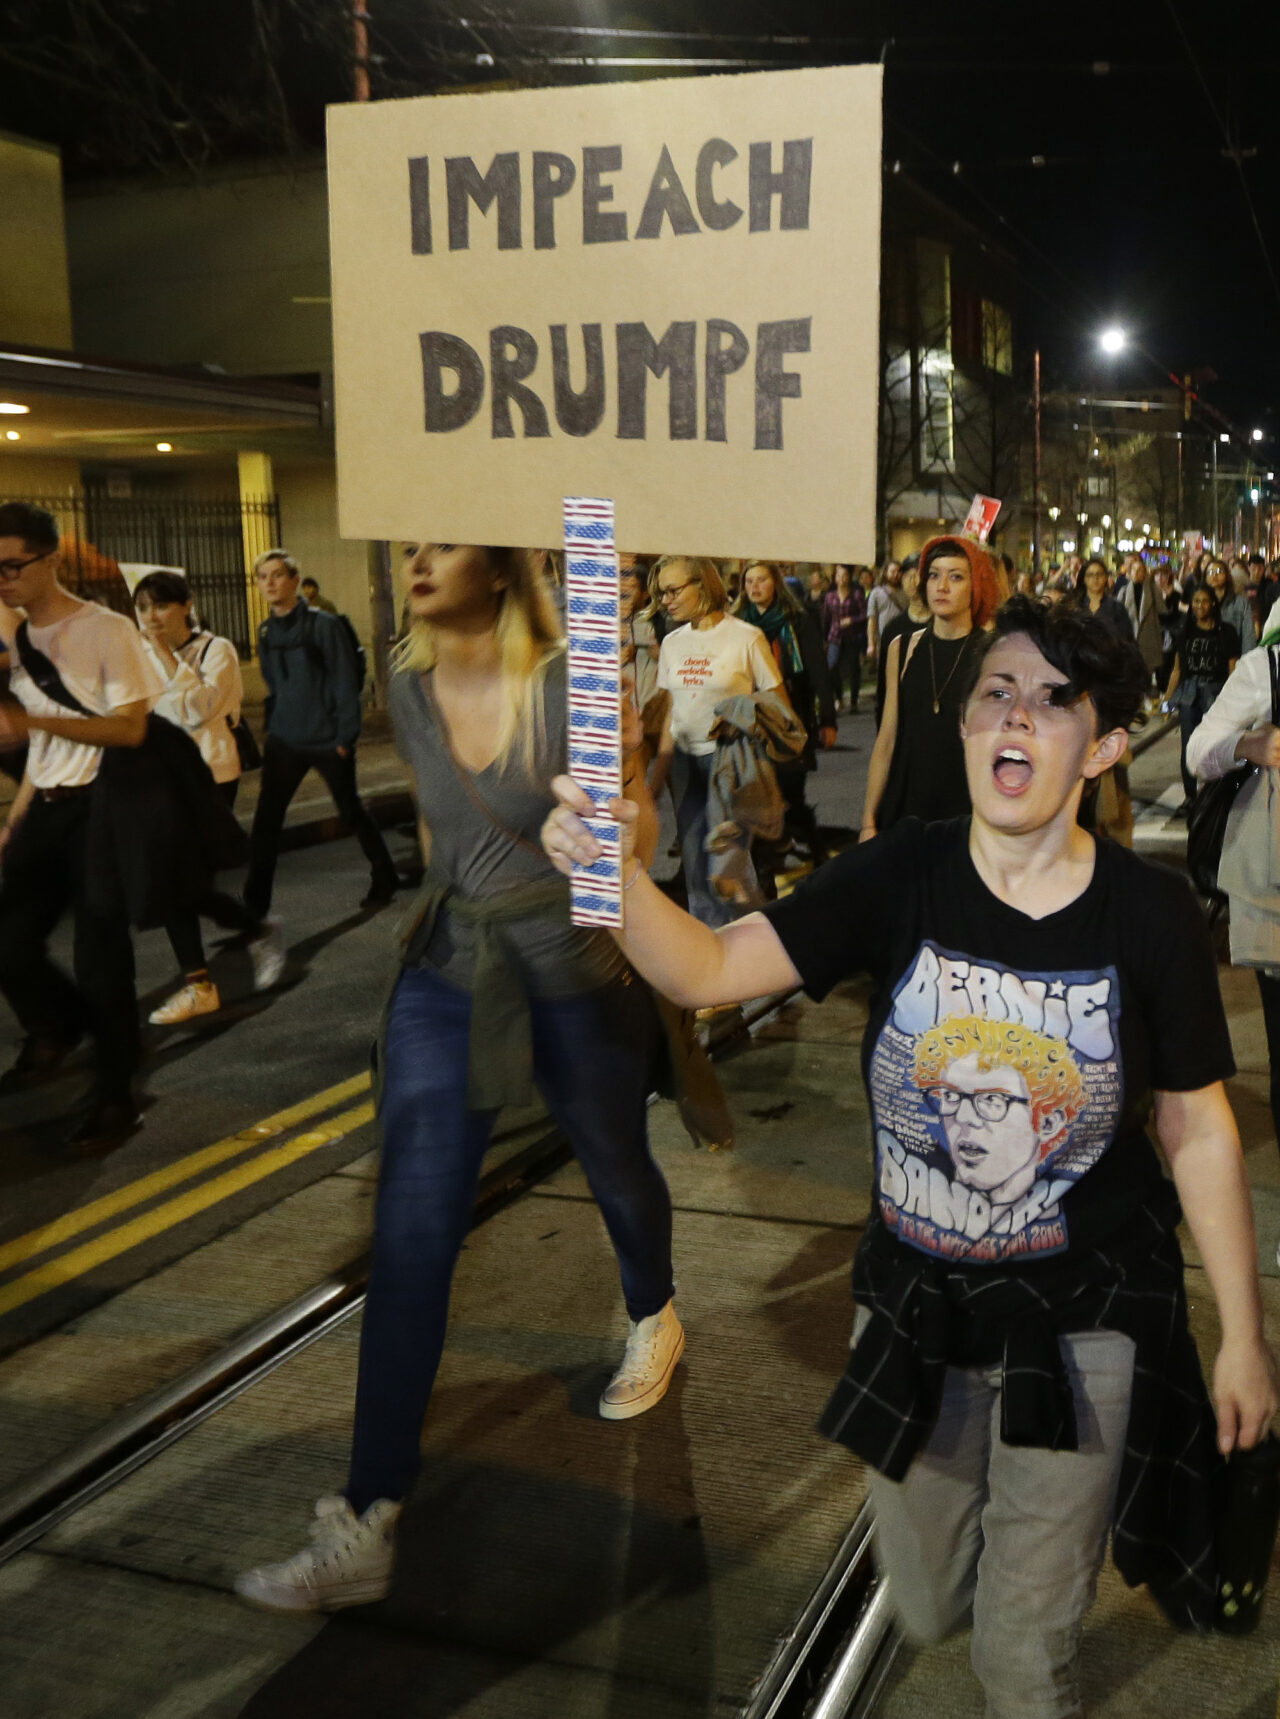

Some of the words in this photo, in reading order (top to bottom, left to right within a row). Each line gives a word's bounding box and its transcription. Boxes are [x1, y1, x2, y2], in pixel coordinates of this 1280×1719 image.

[407, 137, 813, 255] IMPEACH
[418, 316, 813, 450] DRUMPF
[1030, 1221, 1065, 1252] 2016
